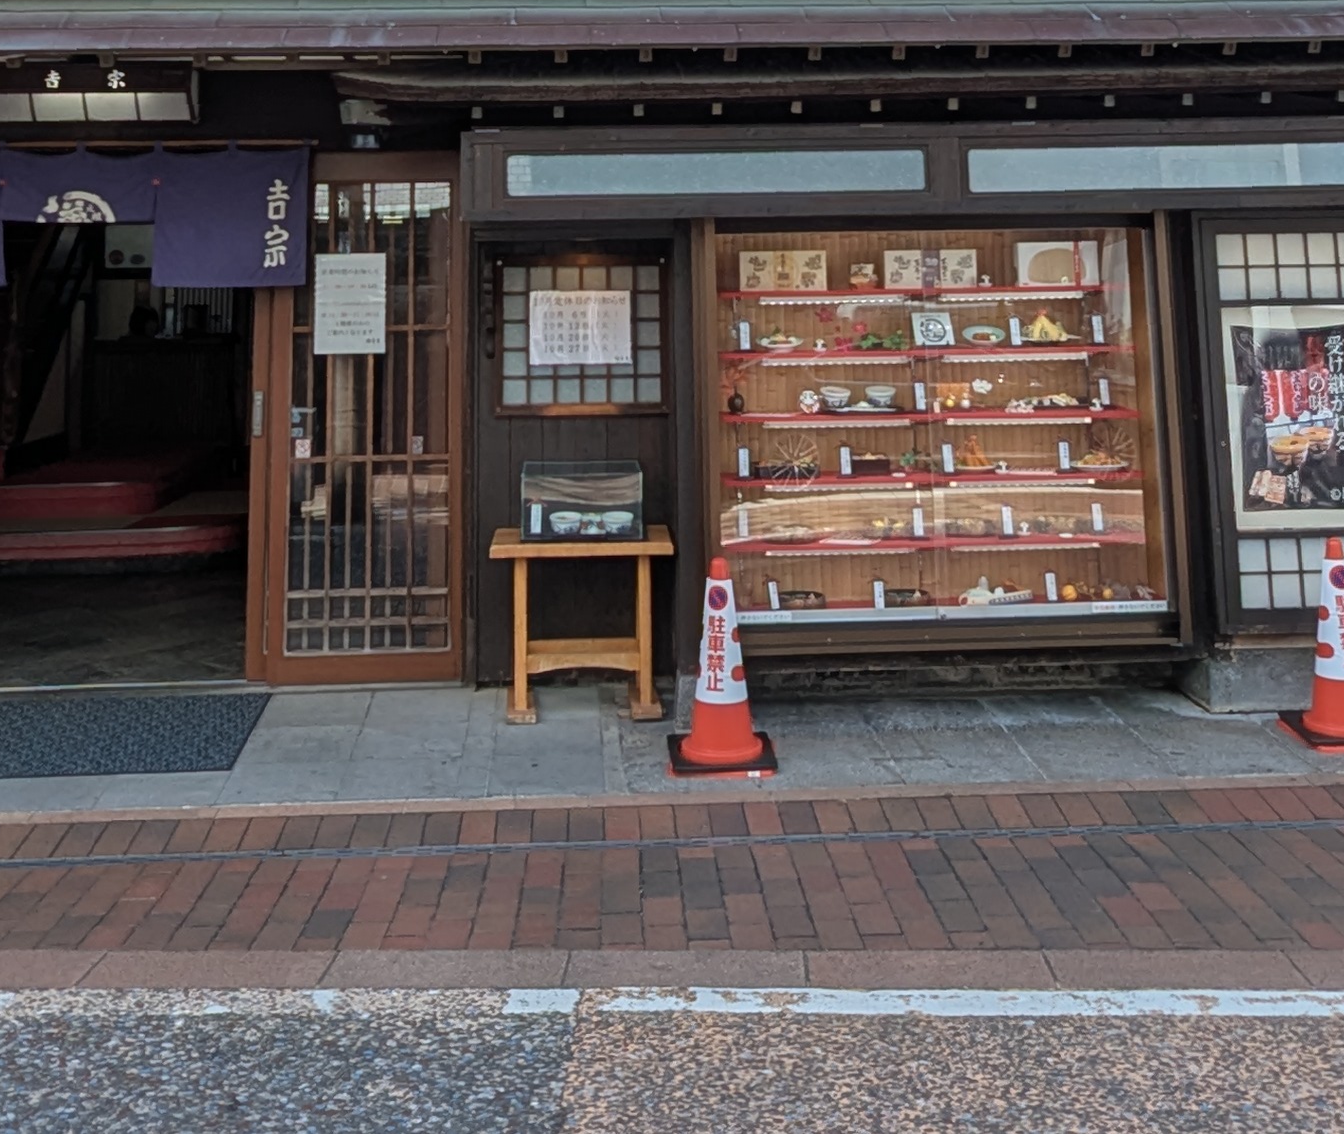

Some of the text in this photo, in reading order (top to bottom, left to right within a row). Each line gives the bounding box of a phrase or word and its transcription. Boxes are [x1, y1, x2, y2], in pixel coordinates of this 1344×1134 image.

[44, 69, 126, 89] 吉宗
[263, 179, 291, 268] 吉宗
[706, 614, 726, 692] 駐車禁止
